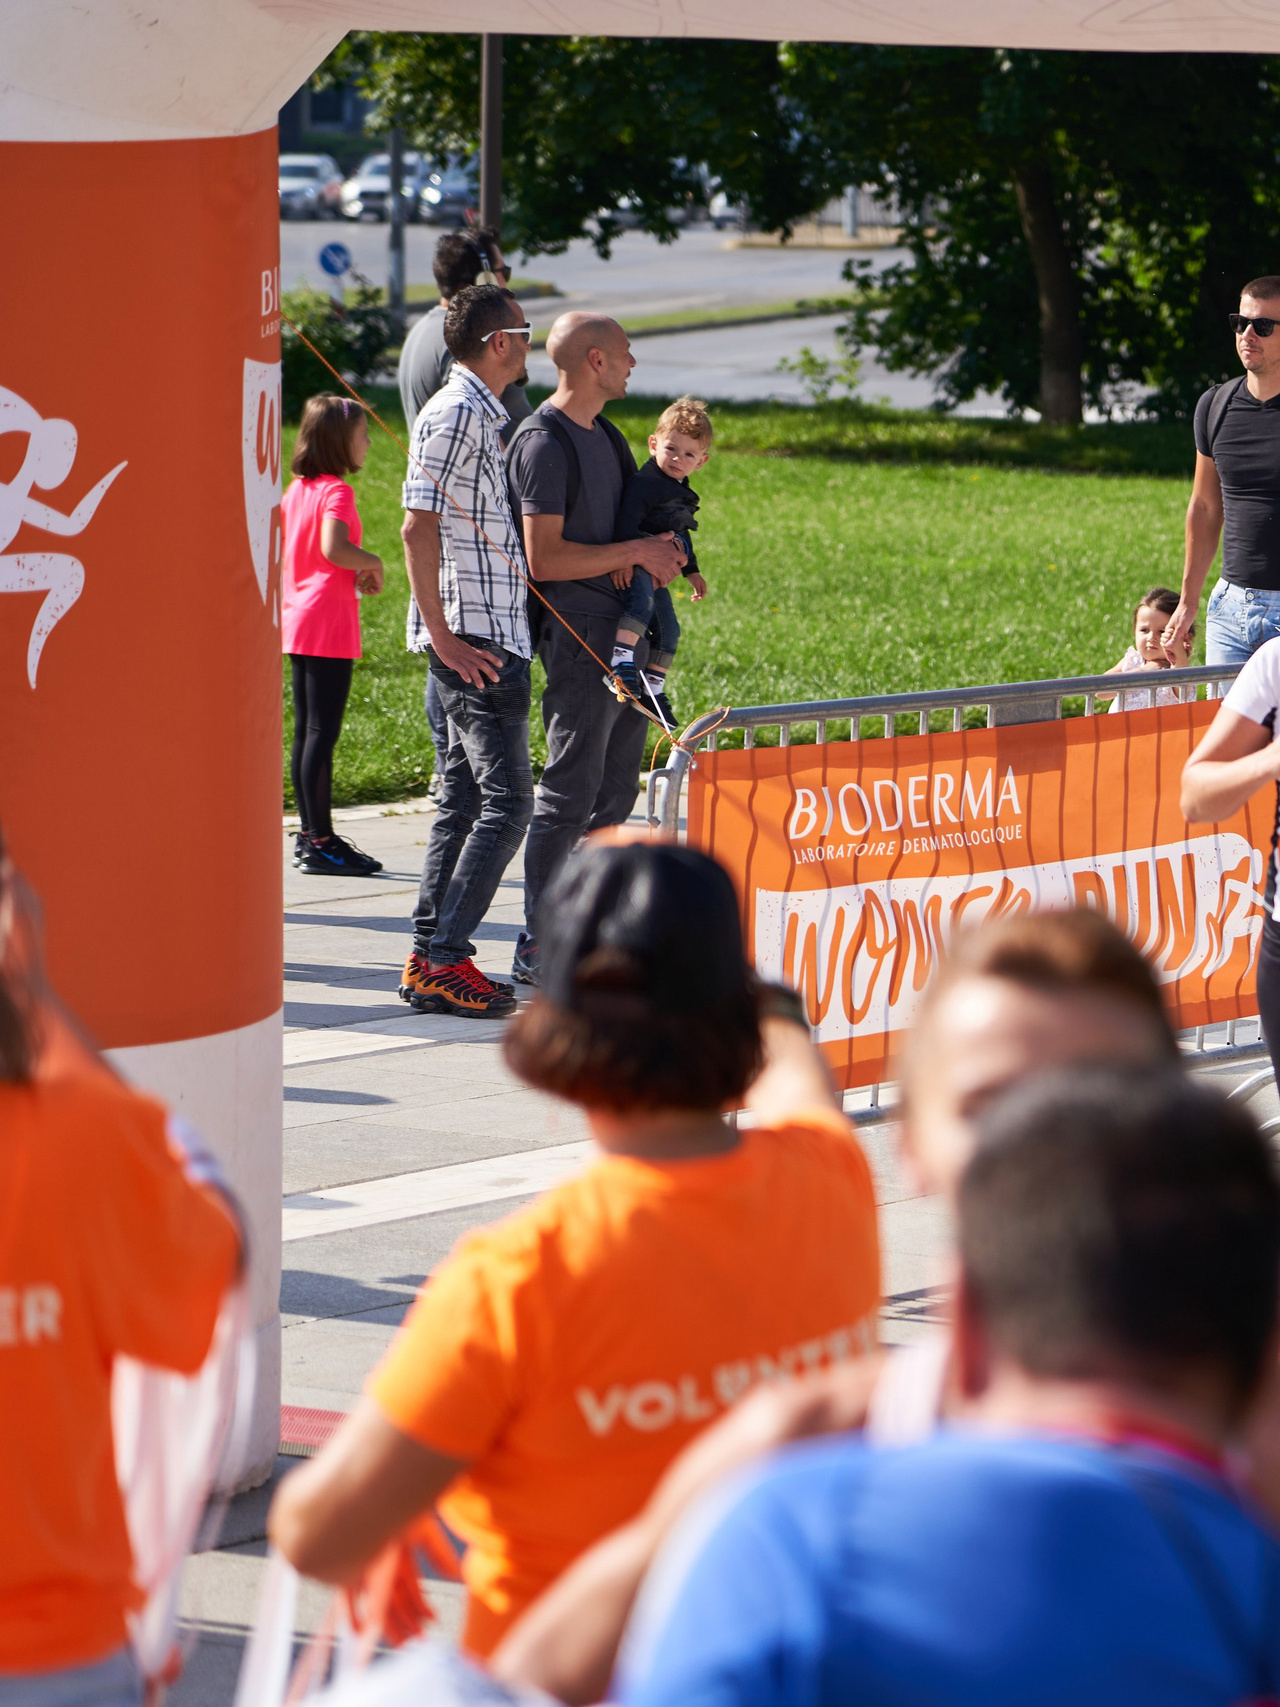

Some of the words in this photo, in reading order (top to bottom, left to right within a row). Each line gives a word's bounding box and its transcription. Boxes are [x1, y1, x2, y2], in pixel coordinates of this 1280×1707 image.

[790, 765, 1022, 840] BIODERMA
[793, 841, 896, 865] LABORATOIRE
[902, 824, 1022, 855] DERMATOLOGIQUE
